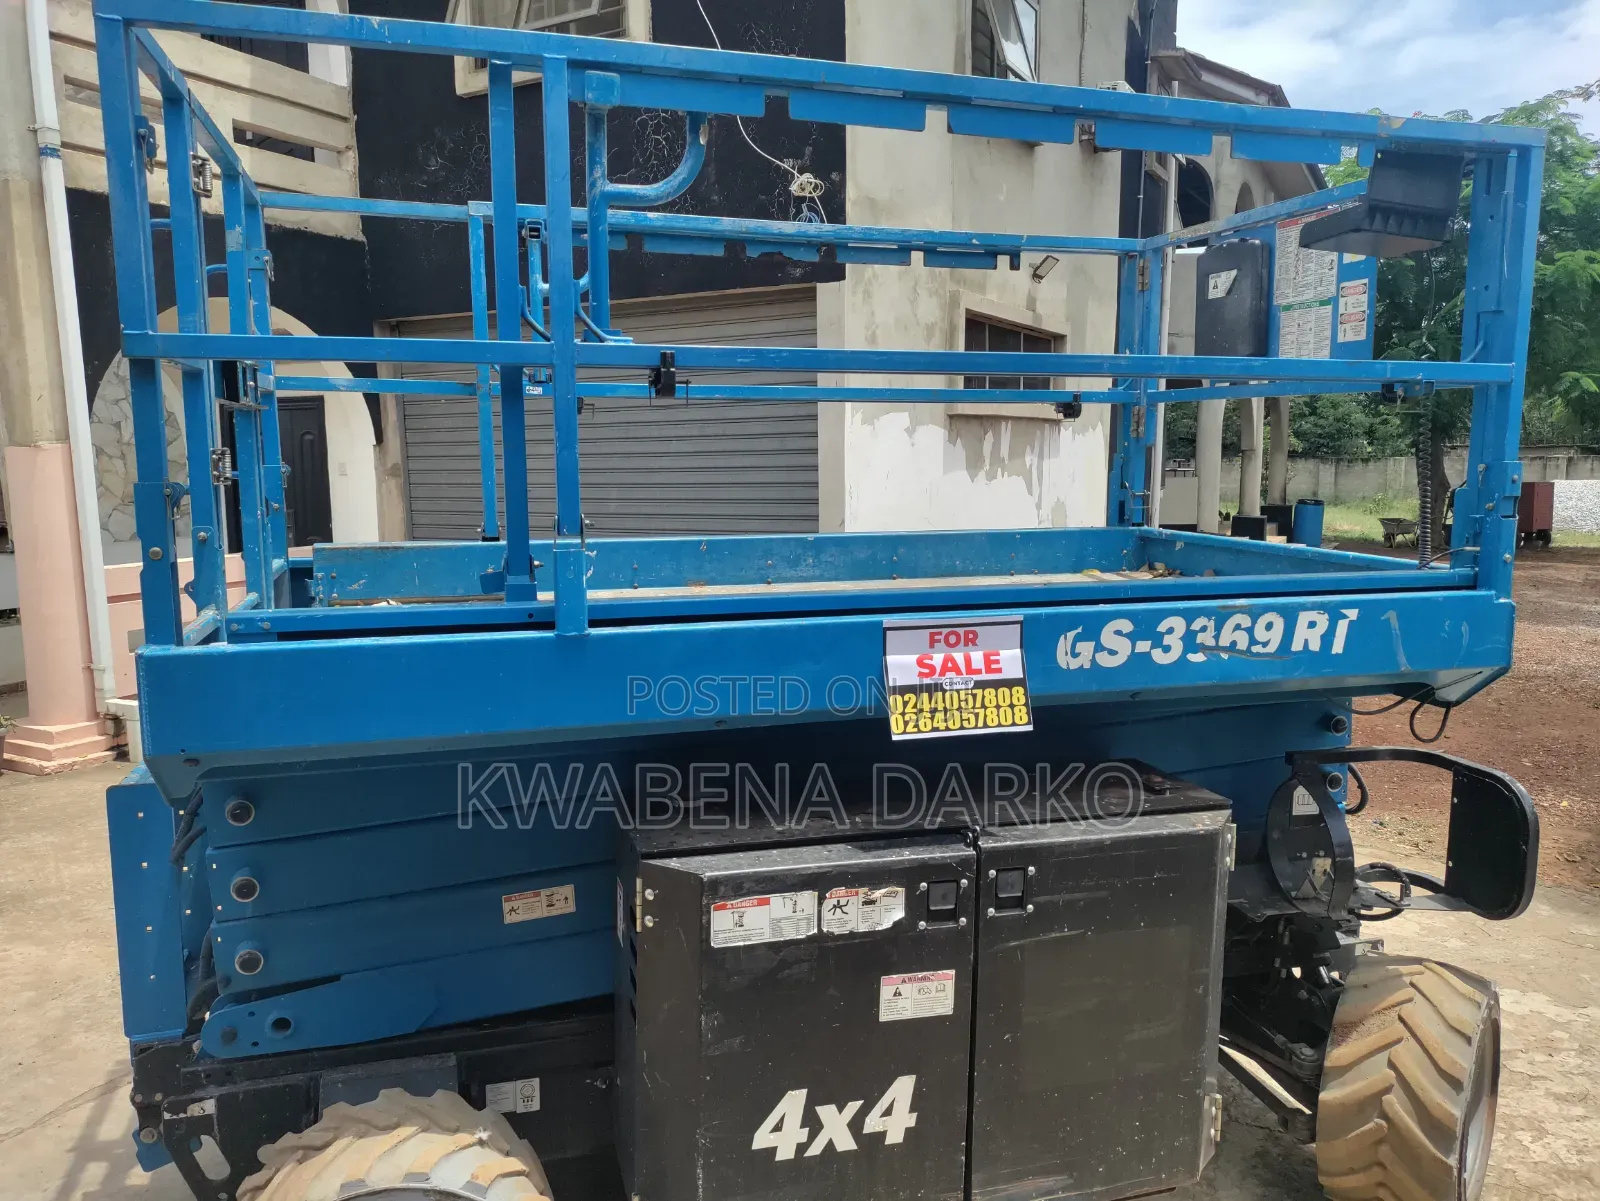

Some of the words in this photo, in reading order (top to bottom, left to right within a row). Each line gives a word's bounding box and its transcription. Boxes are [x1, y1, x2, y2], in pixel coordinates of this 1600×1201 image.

[928, 629, 979, 649] FOR
[1056, 612, 1284, 669] GS-3369
[915, 650, 1003, 679] SALE
[944, 679, 973, 688] CONTACT
[890, 686, 1026, 714] 0244057808
[891, 706, 1028, 734] 0264057808
[733, 899, 758, 908] DANGER
[831, 890, 856, 898] DANGER
[752, 1075, 918, 1161] 4x4
